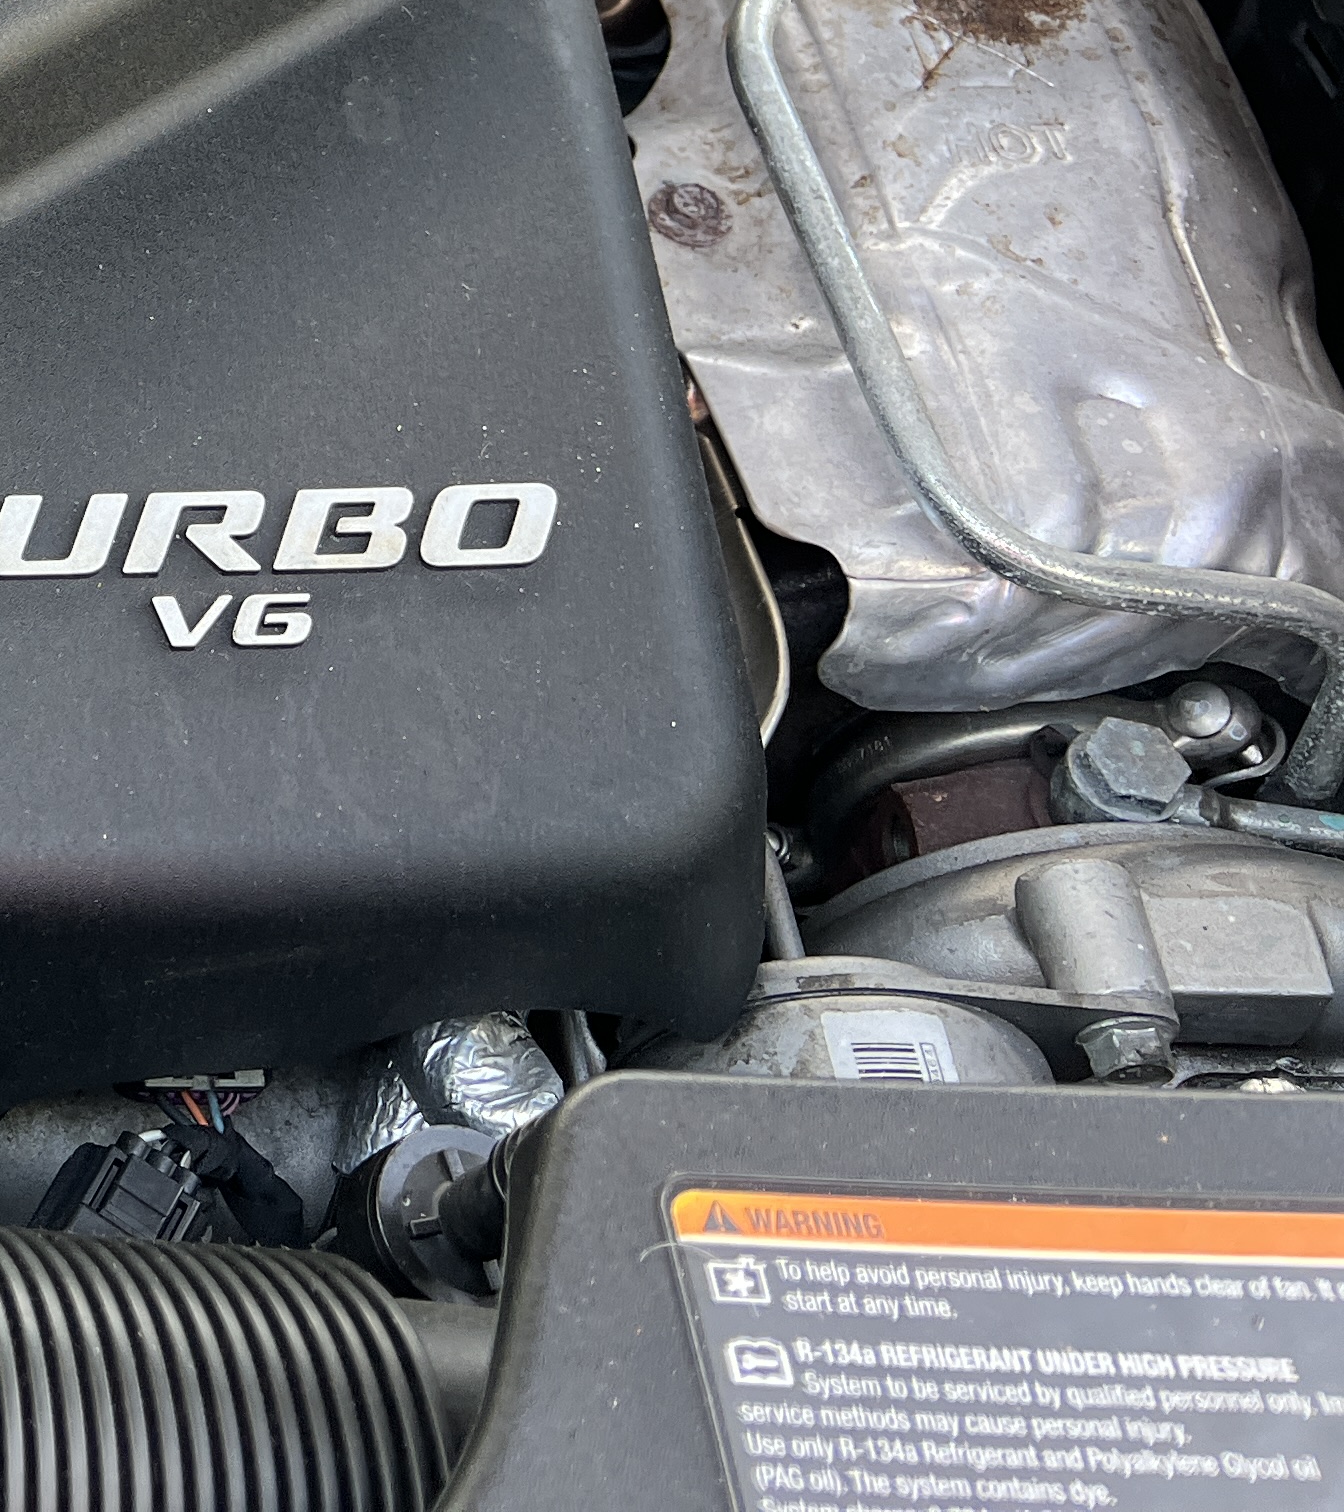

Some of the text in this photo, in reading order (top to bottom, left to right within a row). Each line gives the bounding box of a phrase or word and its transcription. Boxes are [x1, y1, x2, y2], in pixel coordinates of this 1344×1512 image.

[941, 120, 1074, 163] HOT
[150, 592, 313, 649] V6
[745, 1209, 885, 1238] WARNING
[775, 1257, 801, 1280] To
[807, 1260, 850, 1285] help
[857, 1263, 910, 1285] avoid
[916, 1267, 1002, 1291] personal
[1006, 1271, 1071, 1298] injury,
[1071, 1271, 1124, 1298] keep
[1126, 1272, 1193, 1296] hands
[783, 1293, 959, 1321] start at any time.
[794, 1337, 1300, 1383] R-134a REFRIGERANT UNDER HIGH PRESSURE
[803, 1370, 883, 1399] System
[887, 1375, 909, 1399] to
[912, 1376, 940, 1401] be
[944, 1379, 1031, 1404] serviced
[1035, 1381, 1061, 1410] by
[1066, 1384, 1156, 1411] qualified
[738, 1401, 814, 1425] service
[820, 1405, 910, 1430] methods
[914, 1411, 961, 1436] may
[964, 1413, 1028, 1436] cause
[1029, 1416, 1123, 1442] personal
[742, 1431, 787, 1456] Use
[791, 1434, 835, 1464] only
[838, 1435, 919, 1462] R-134a
[922, 1439, 1039, 1472] Refrigerant
[1040, 1446, 1085, 1470] and
[754, 1463, 804, 1497] (PAG
[847, 1467, 890, 1495] The
[894, 1472, 972, 1502] system
[975, 1478, 1068, 1504] contains
